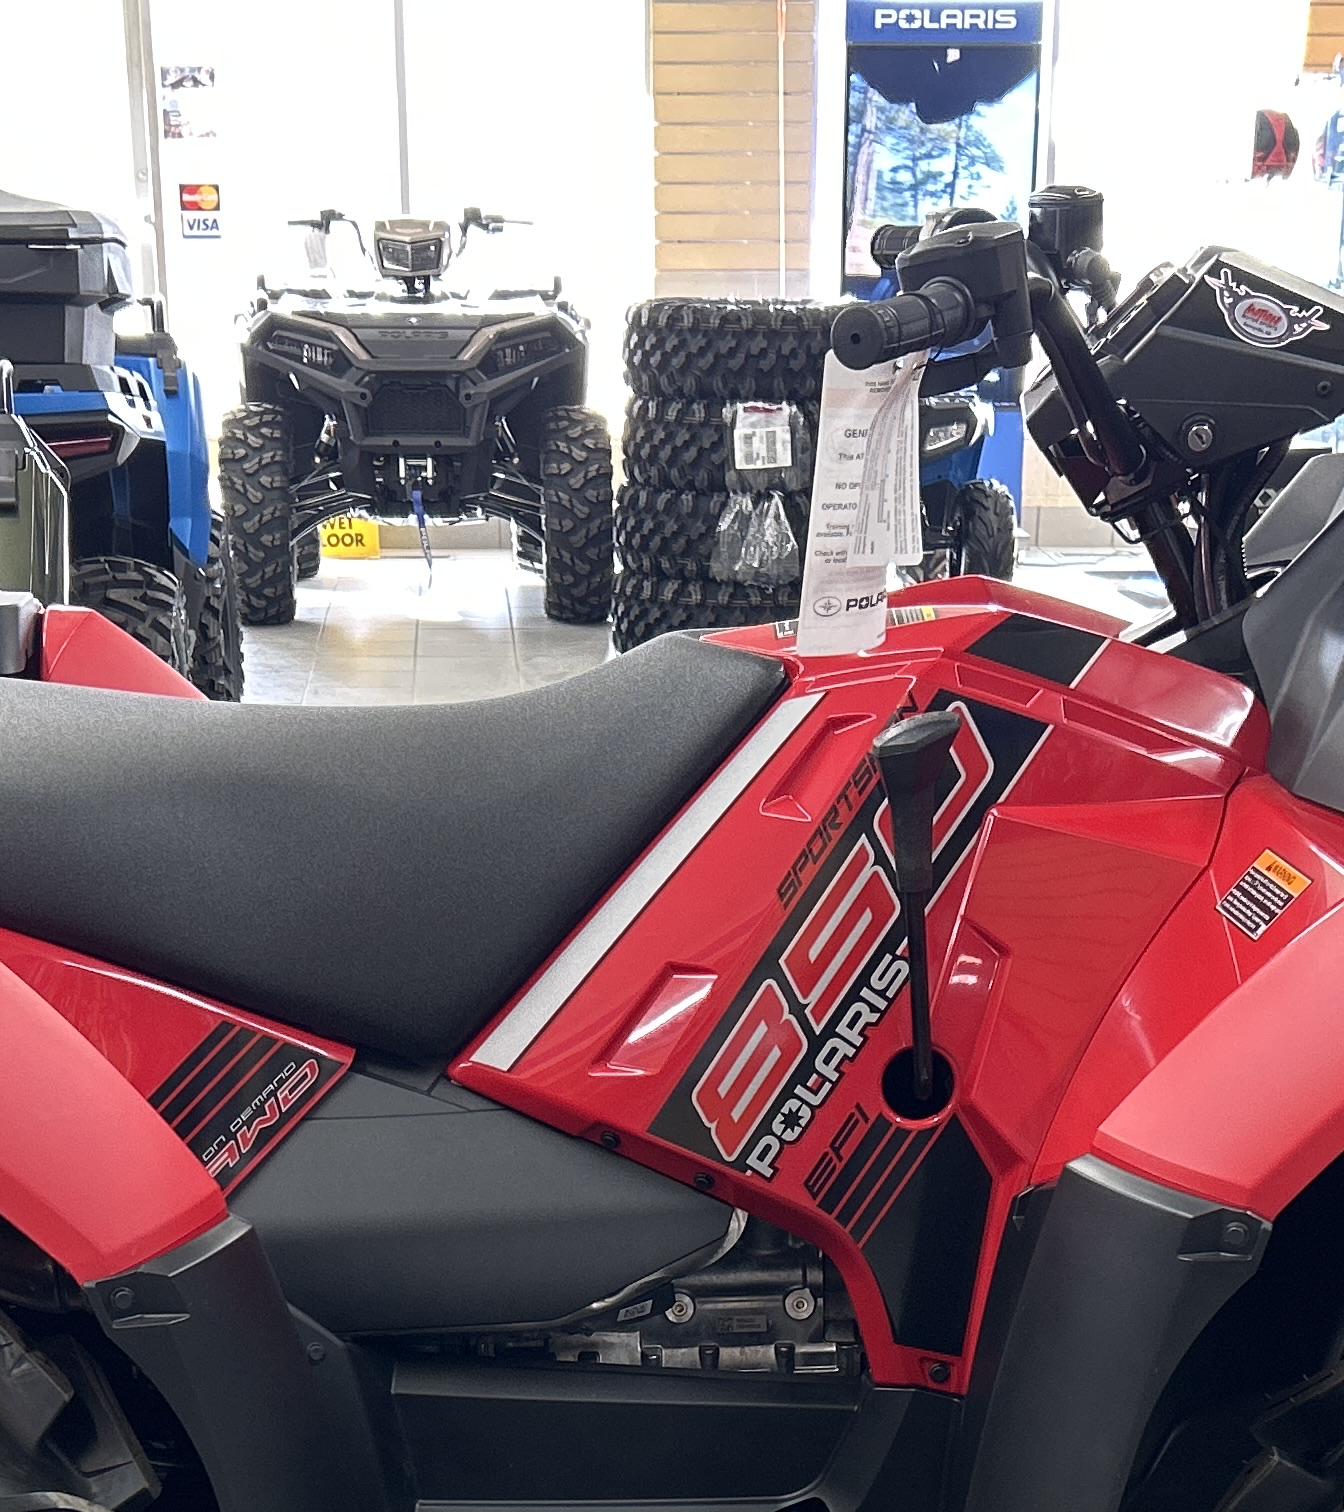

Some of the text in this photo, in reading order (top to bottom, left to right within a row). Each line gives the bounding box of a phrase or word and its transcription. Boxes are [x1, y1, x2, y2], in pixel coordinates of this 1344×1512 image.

[874, 8, 1017, 29] POLARIS
[187, 218, 220, 231] VISA
[322, 533, 366, 548] OOR
[821, 502, 858, 512] OPERATO
[776, 690, 919, 912] SPORTSN
[692, 700, 995, 1163] 850
[202, 1061, 297, 1162] ON DEMAND
[746, 952, 912, 1180] POLARIS
[205, 1058, 320, 1178] AWD
[803, 1102, 870, 1200] EFI
